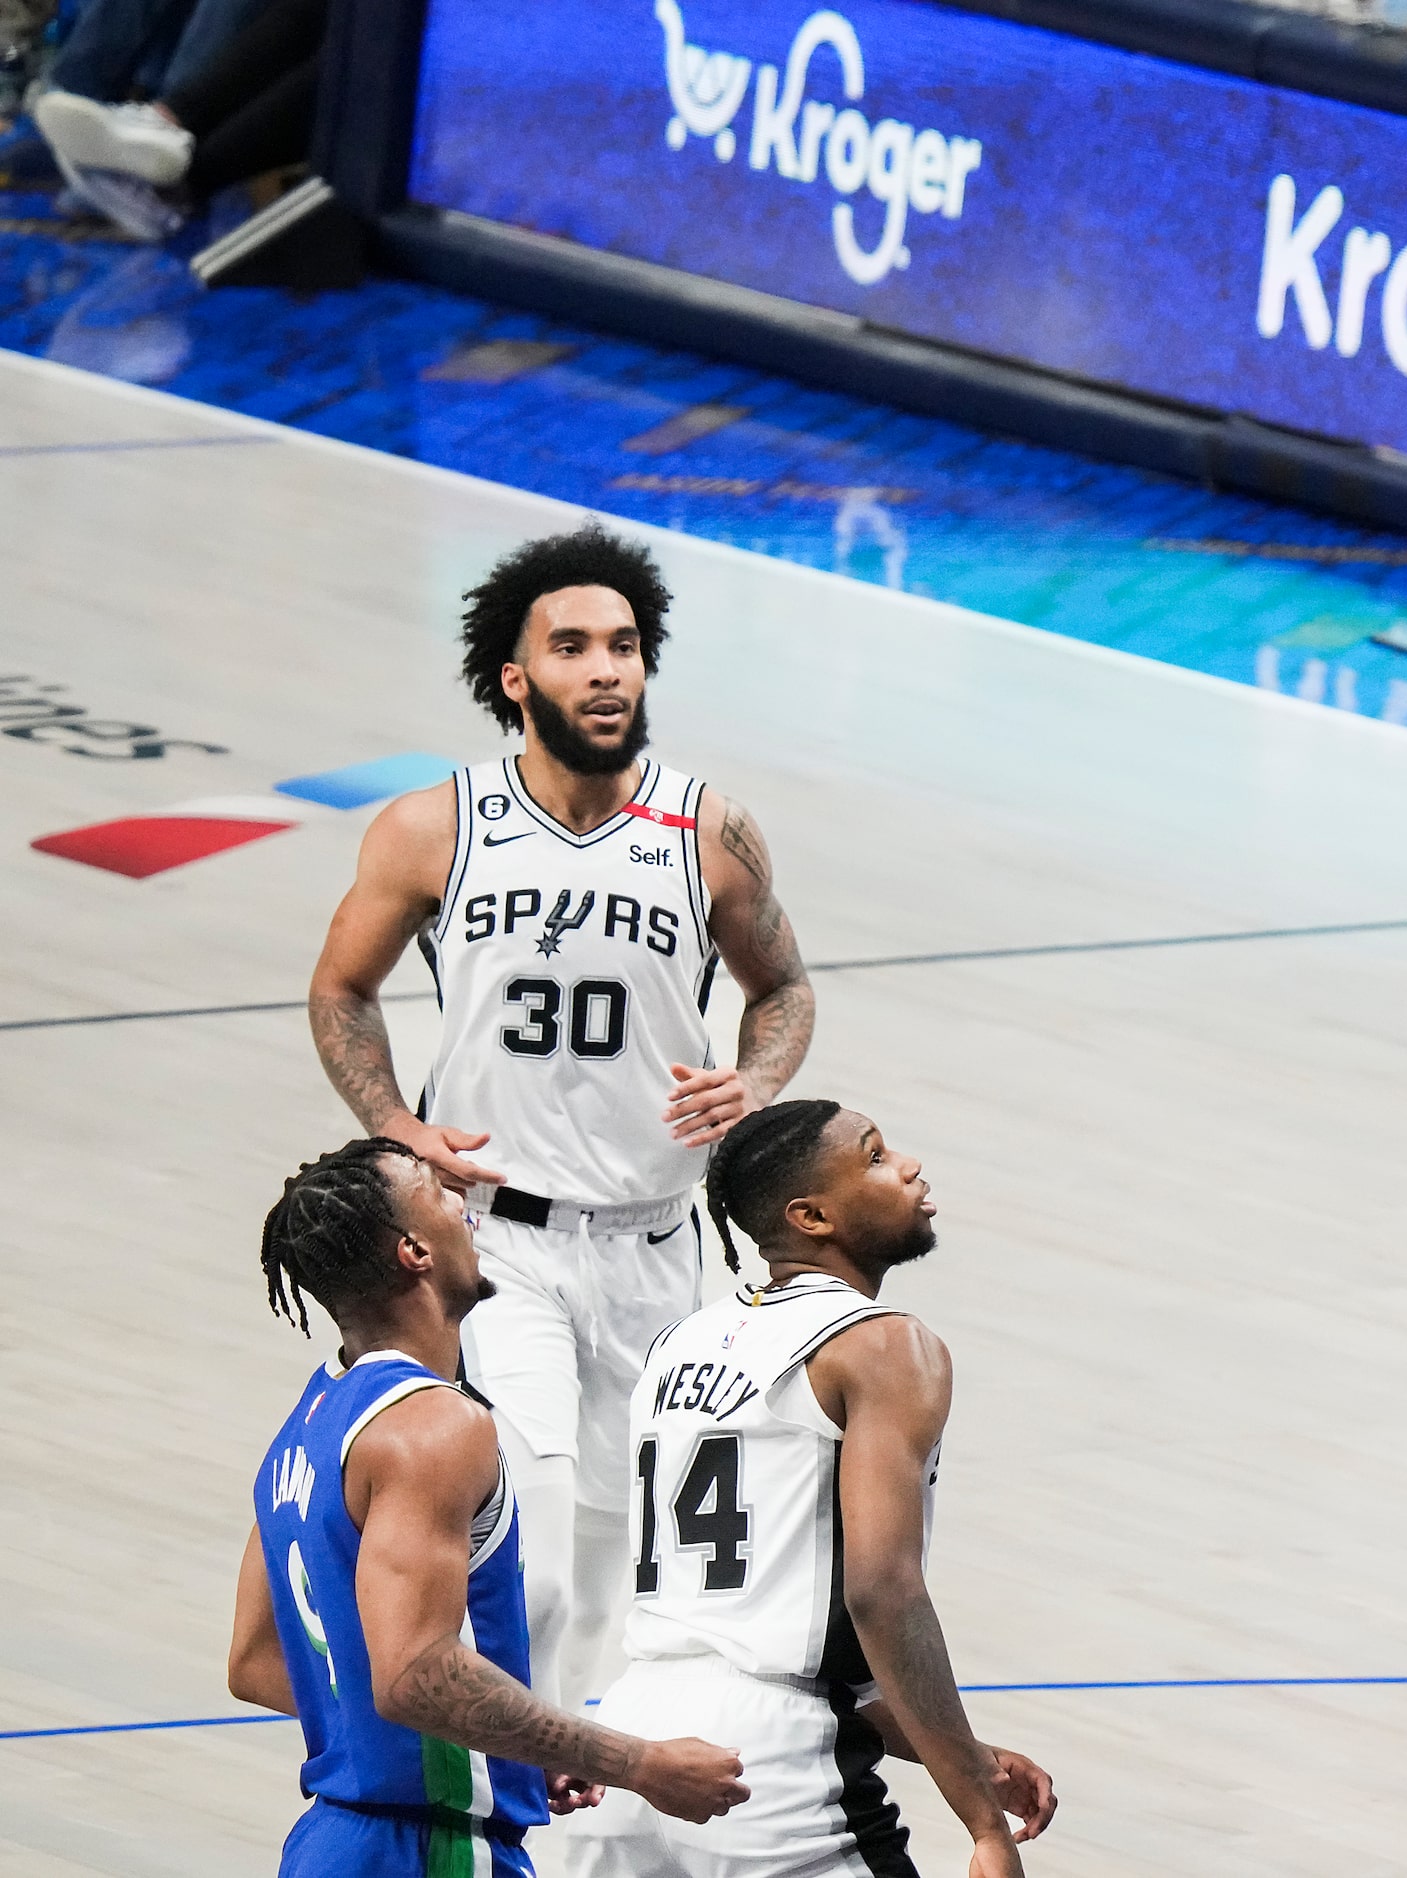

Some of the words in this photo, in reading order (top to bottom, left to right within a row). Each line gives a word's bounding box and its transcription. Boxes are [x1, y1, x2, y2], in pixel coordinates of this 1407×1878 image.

[749, 8, 983, 285] Kroger
[484, 796, 506, 819] 6
[629, 844, 674, 868] Self.
[465, 888, 679, 960] SPURS
[500, 974, 631, 1061] 30
[652, 1362, 759, 1422] WESLEY
[633, 1429, 755, 1602] 14
